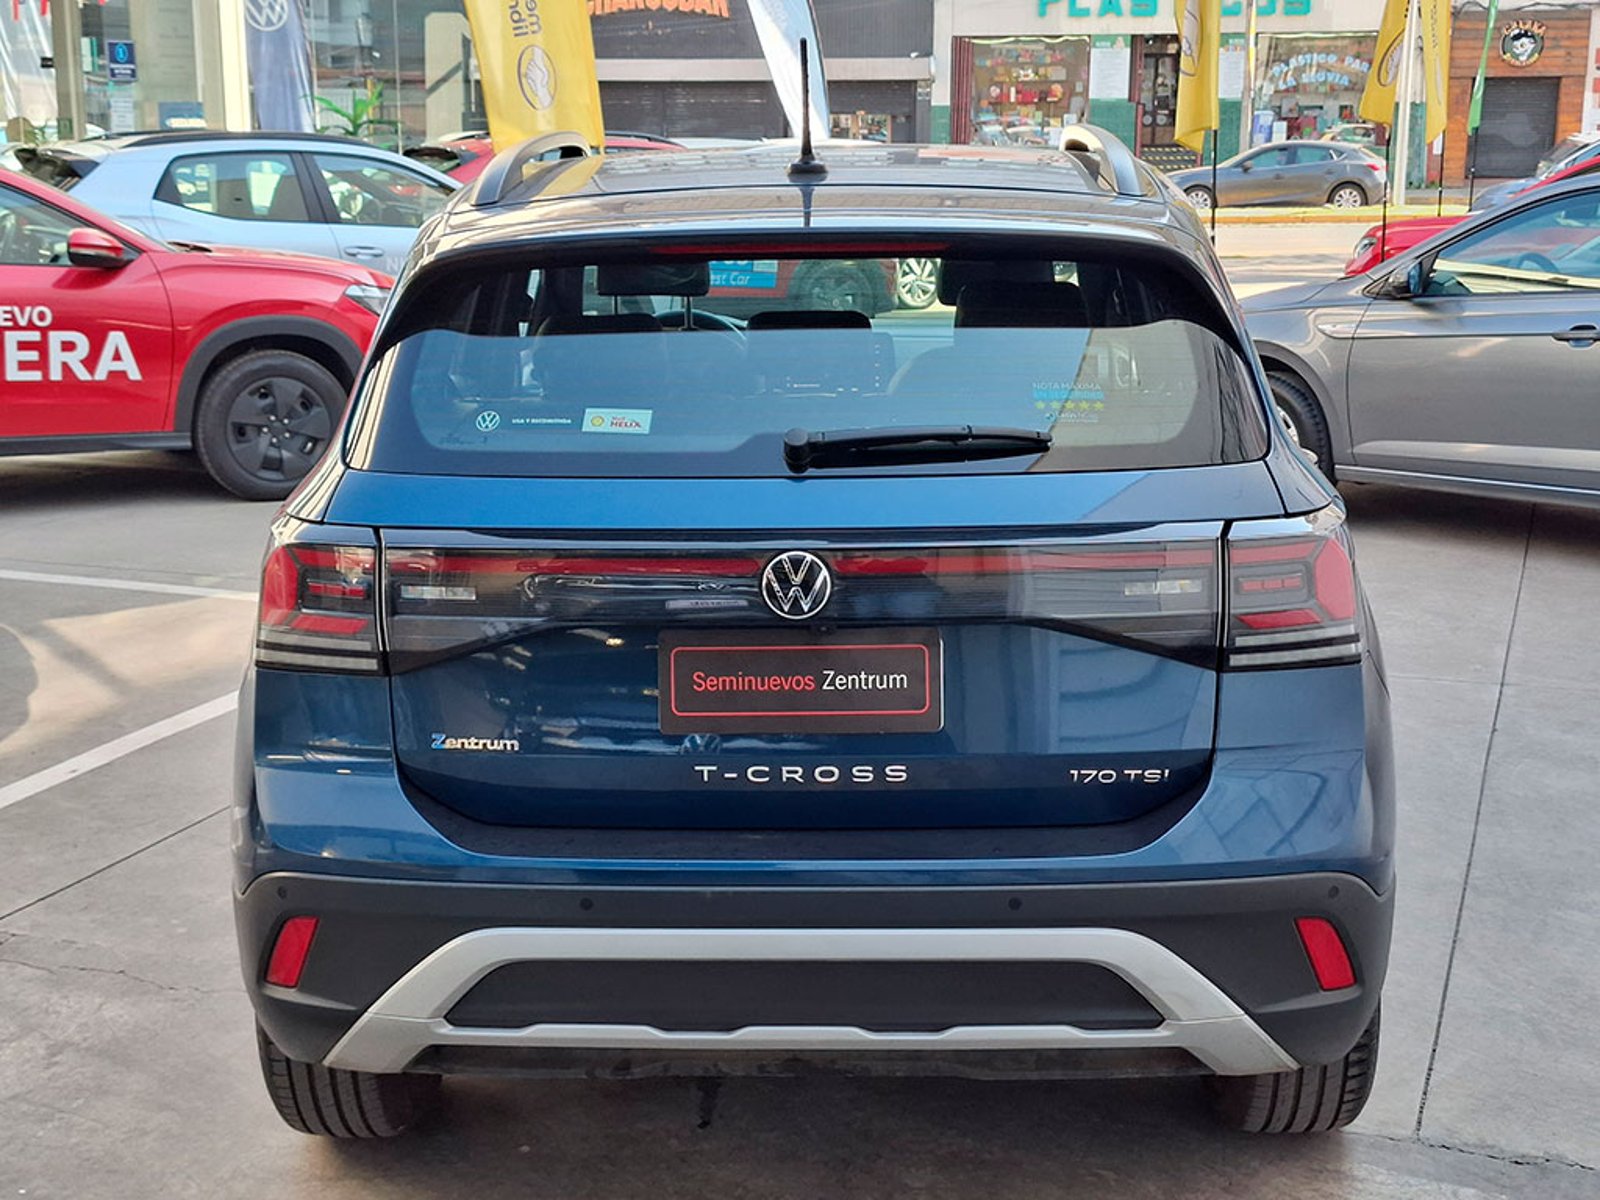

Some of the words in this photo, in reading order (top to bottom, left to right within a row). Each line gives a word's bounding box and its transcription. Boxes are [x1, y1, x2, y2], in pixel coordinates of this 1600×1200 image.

[1344, 55, 1371, 73] PAR
[730, 272, 750, 285] Car
[693, 671, 815, 692] Seminuevos
[821, 670, 909, 691] Zentrum
[431, 732, 519, 751] Zentrum
[694, 765, 908, 783] T-CROSS
[1069, 769, 1117, 783] 170
